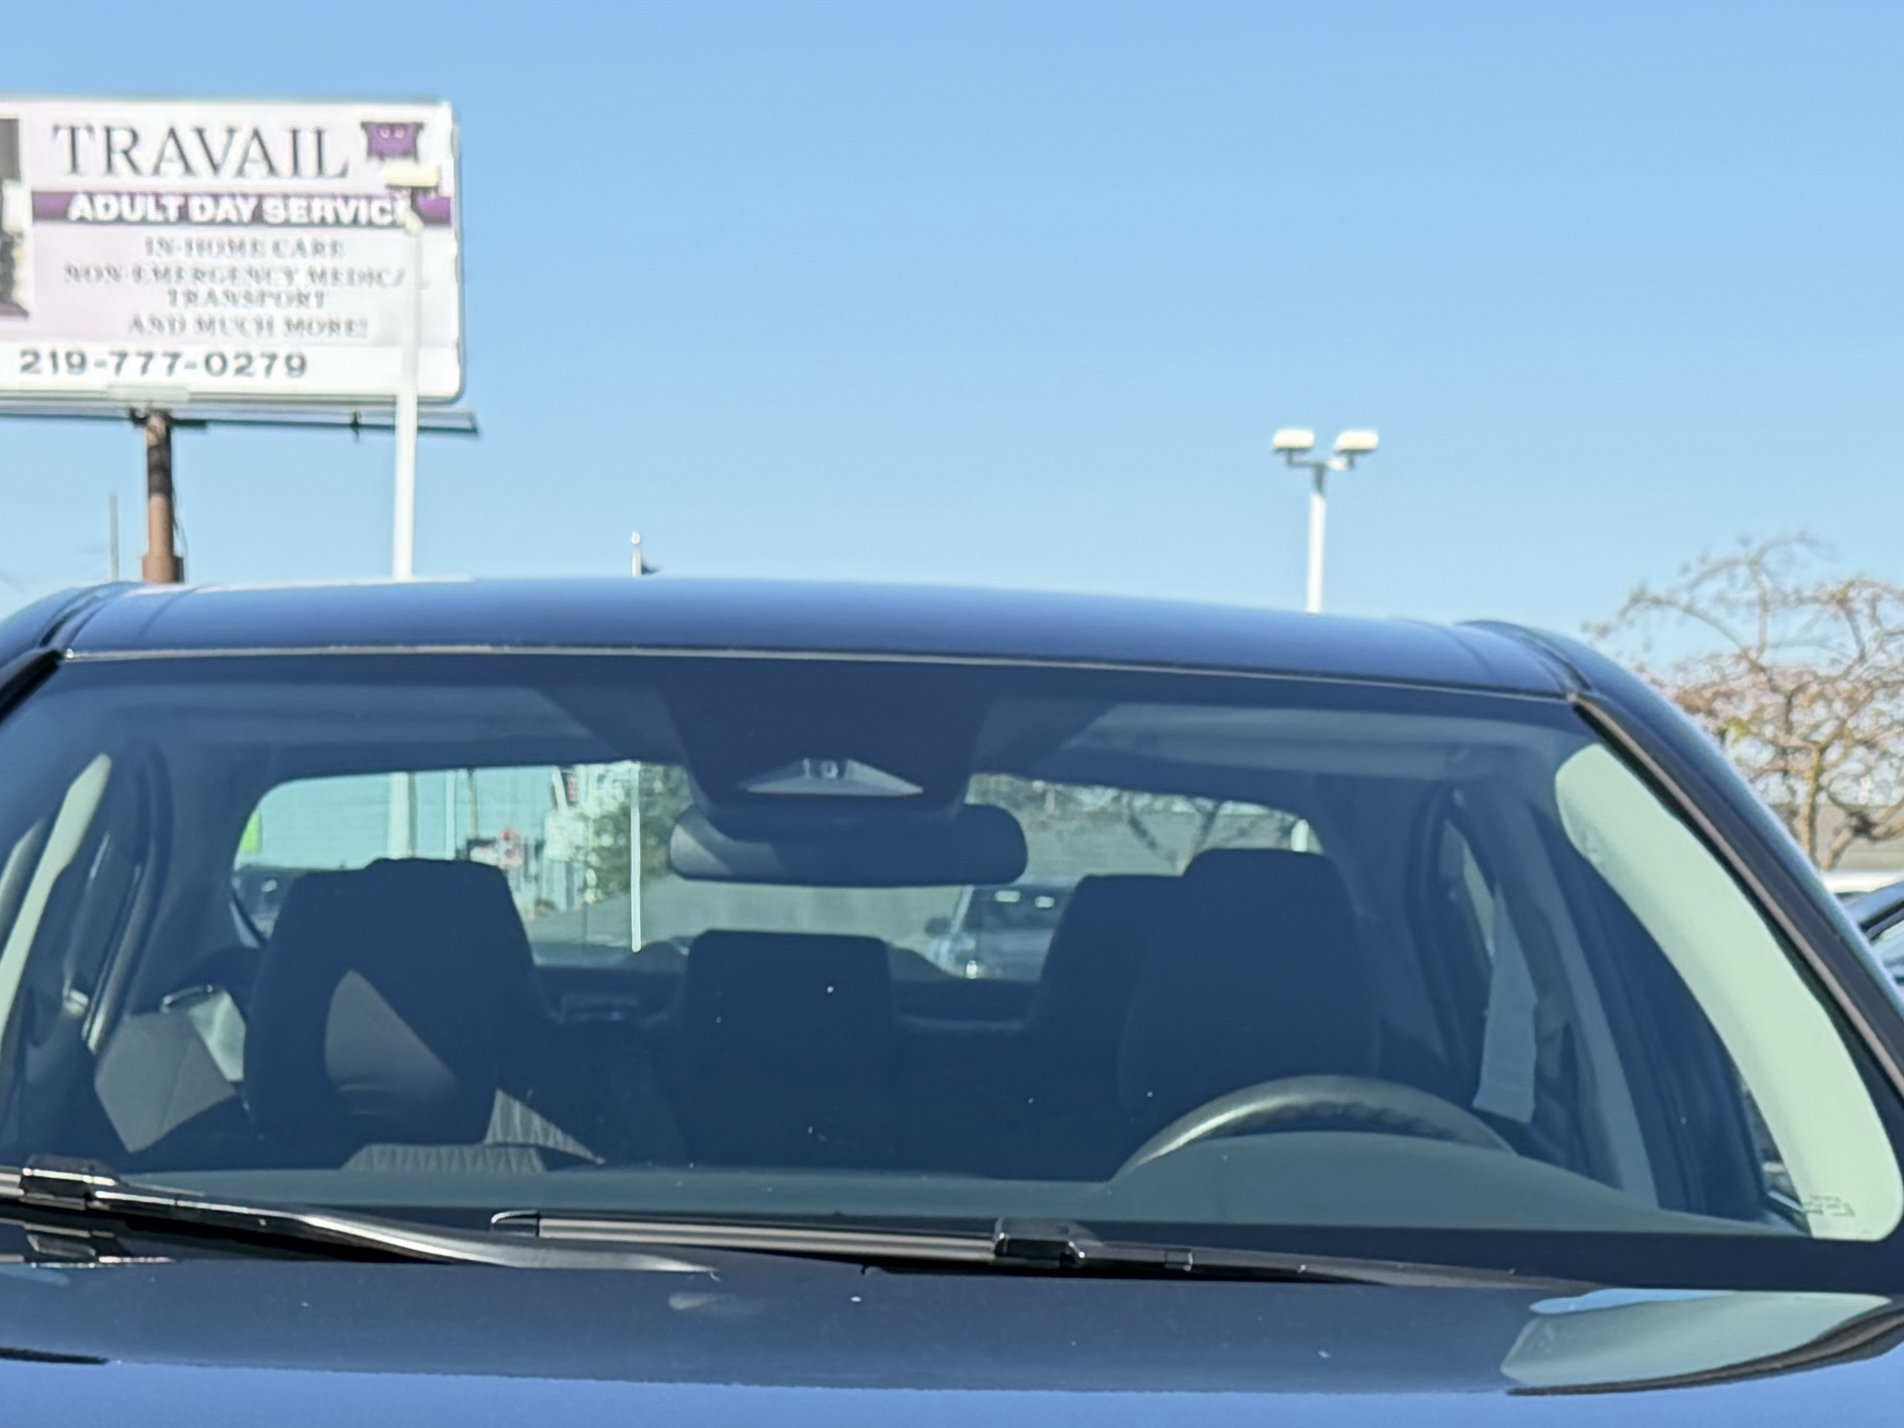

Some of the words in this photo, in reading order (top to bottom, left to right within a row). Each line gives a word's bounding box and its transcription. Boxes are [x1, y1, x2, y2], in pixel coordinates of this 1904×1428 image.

[52, 122, 351, 179] TRAVAIL
[67, 192, 184, 224] ADULT
[188, 193, 260, 224] DAY
[272, 236, 346, 259] CARE
[308, 265, 429, 289] MEDIC
[167, 287, 326, 309] TRANSPORT
[128, 313, 188, 337] AND
[194, 315, 274, 338] MUCH
[283, 315, 369, 339] MORE!
[18, 347, 309, 379] 219-777-0279
